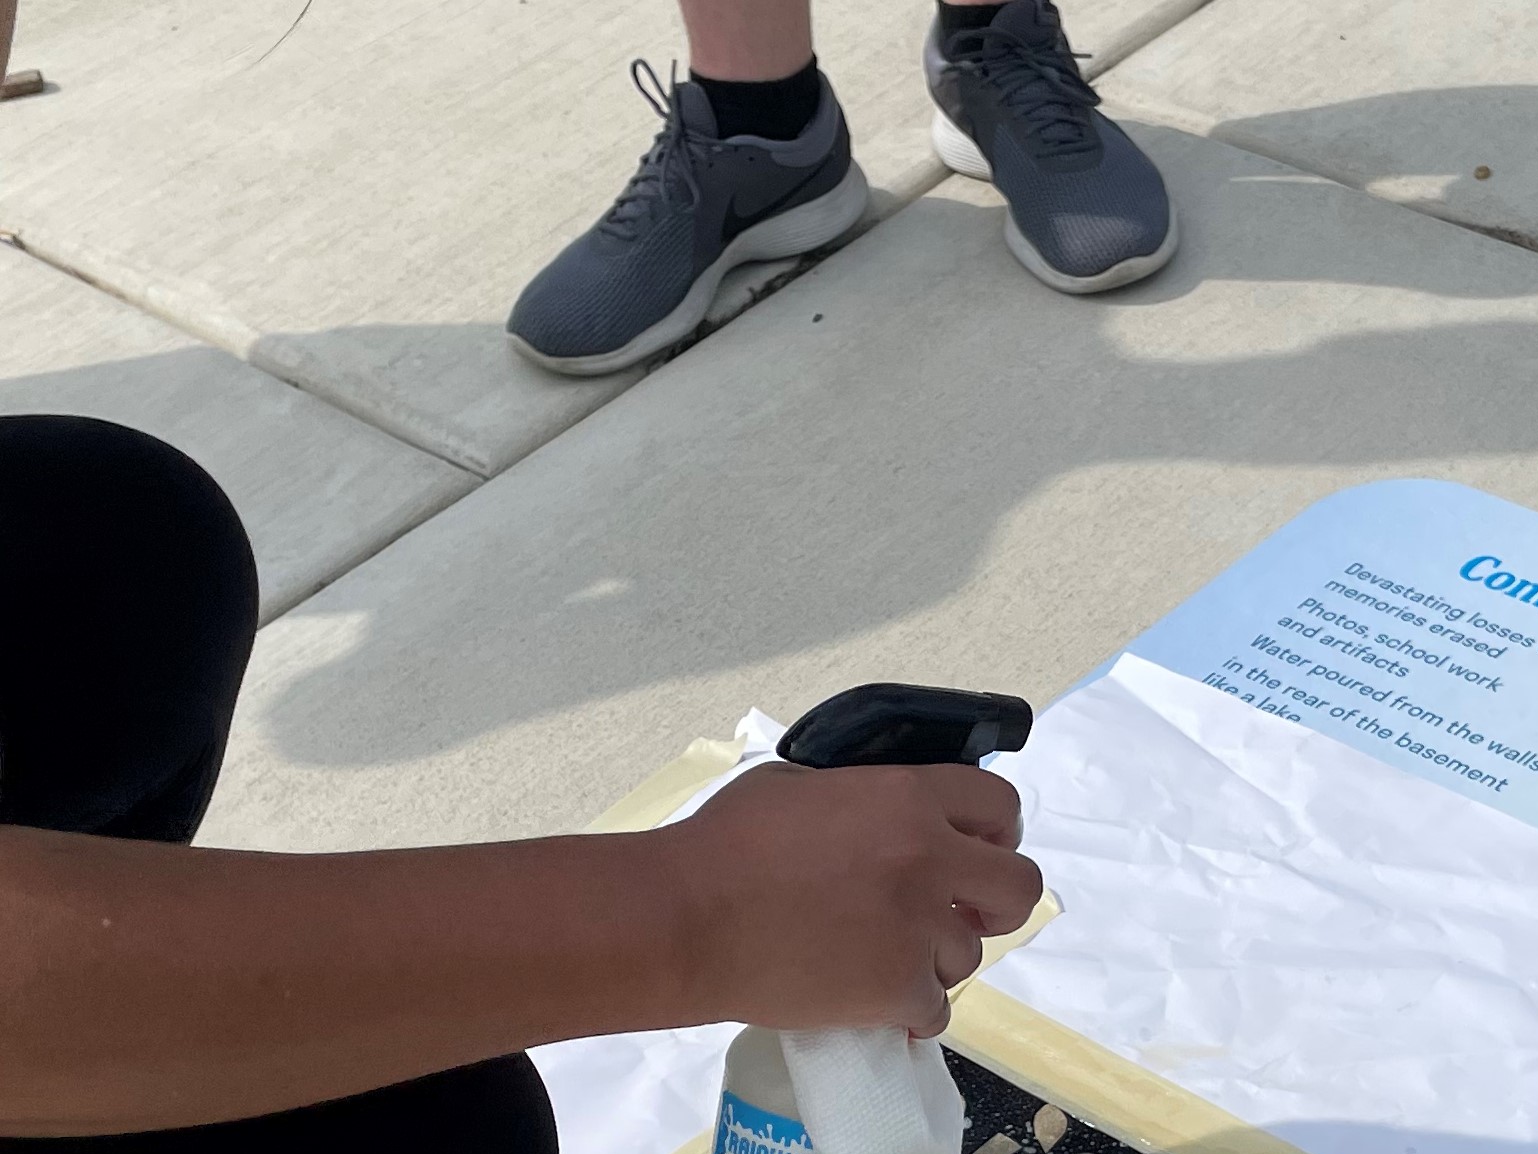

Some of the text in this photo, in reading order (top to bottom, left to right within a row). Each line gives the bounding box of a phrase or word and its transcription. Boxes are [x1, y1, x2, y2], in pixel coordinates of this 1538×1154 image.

[1277, 616, 1410, 678] and artifacts
[1296, 597, 1505, 693] Photos, school work
[1324, 580, 1509, 659] memories erased
[1343, 562, 1467, 622] Devastating
[1466, 611, 1536, 648] losses
[1250, 633, 1313, 668] Water
[1305, 664, 1394, 703] poured
[1388, 695, 1444, 728] from
[1445, 720, 1485, 745] the
